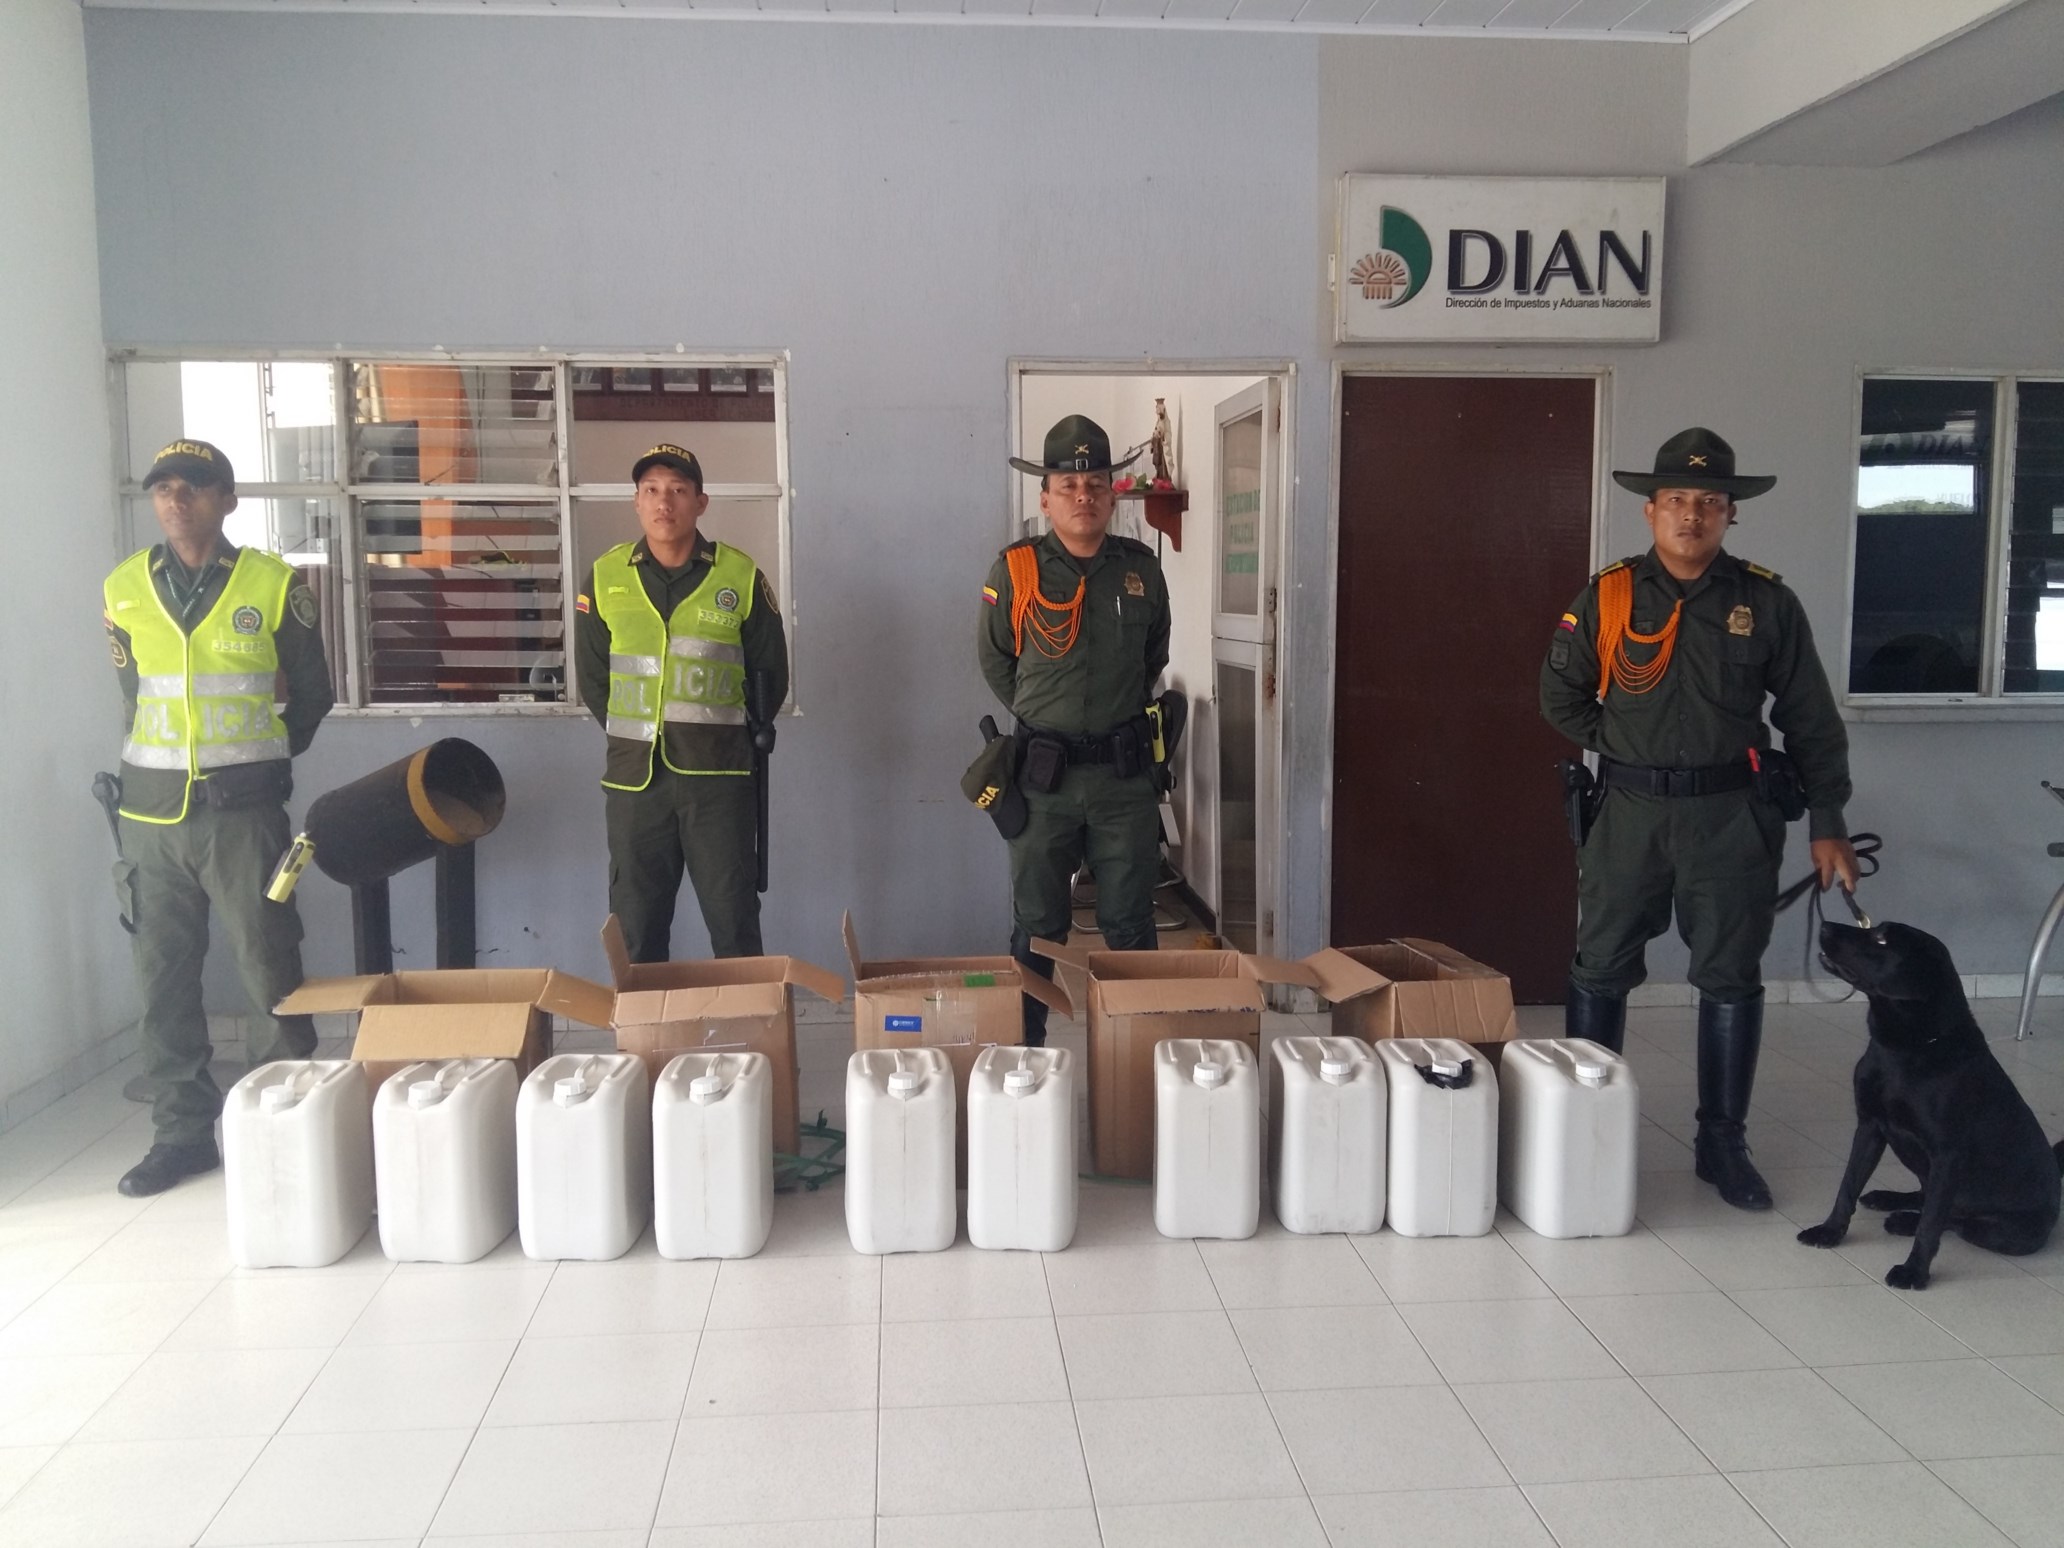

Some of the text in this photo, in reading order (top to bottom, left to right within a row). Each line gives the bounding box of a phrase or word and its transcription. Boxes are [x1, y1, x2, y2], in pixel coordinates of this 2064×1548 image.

[1447, 229, 1652, 295] DIAN
[1445, 297, 1652, 311] Dirección de Impuestos y Aduanas Nacionales
